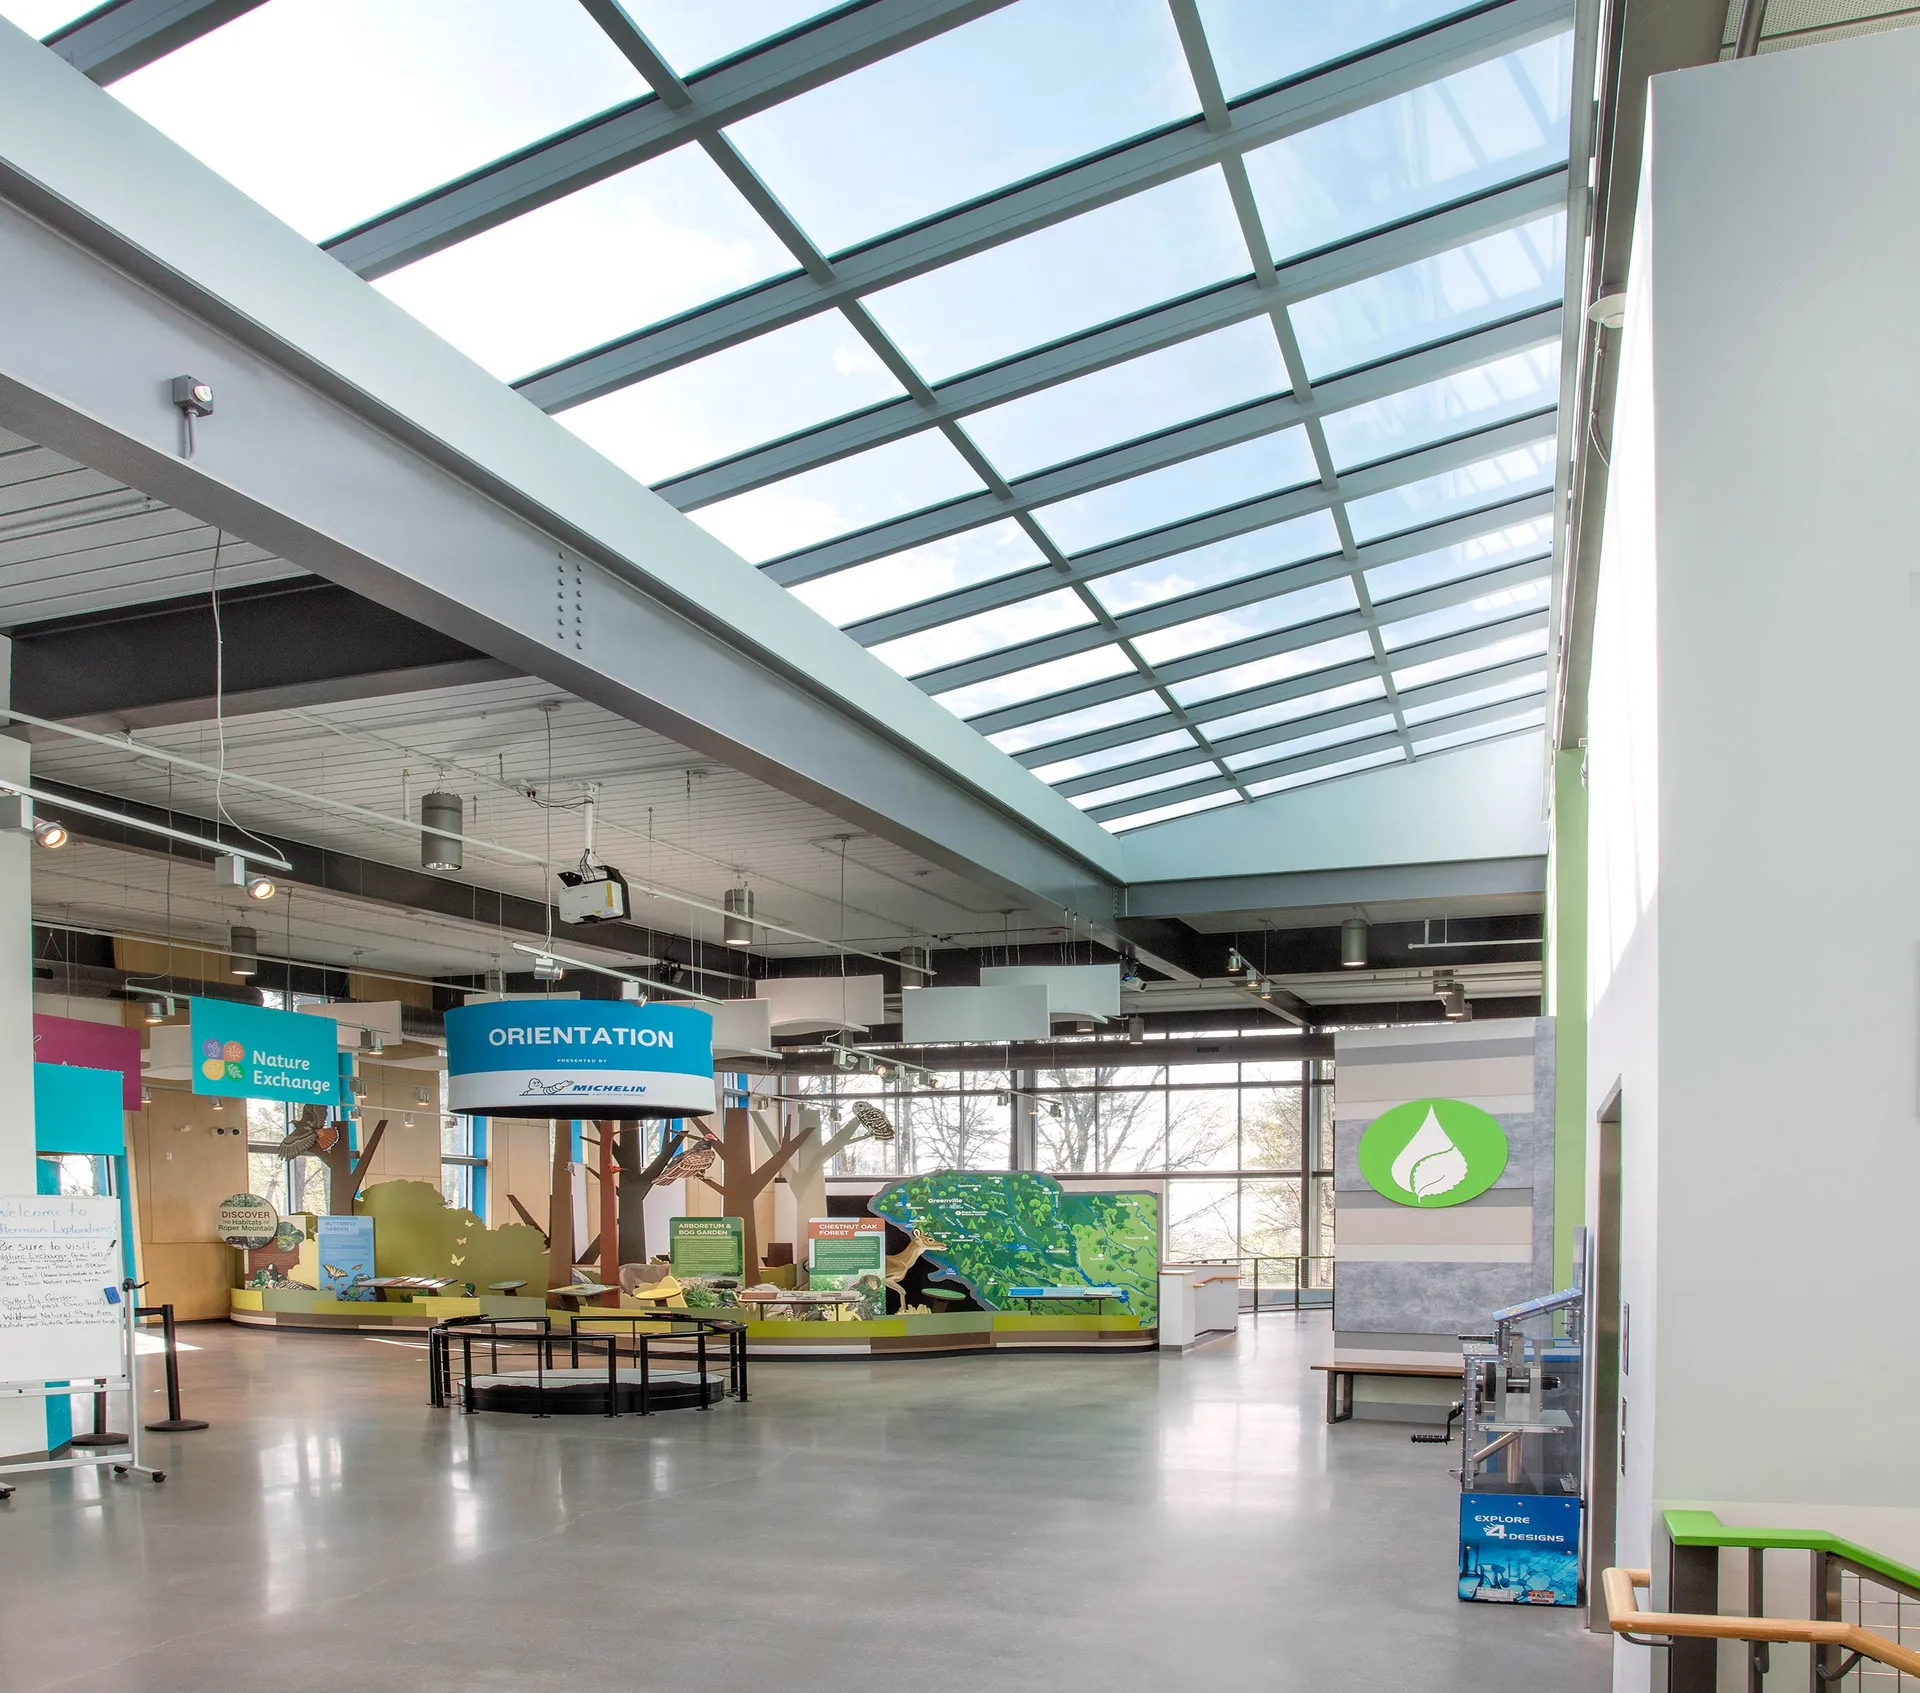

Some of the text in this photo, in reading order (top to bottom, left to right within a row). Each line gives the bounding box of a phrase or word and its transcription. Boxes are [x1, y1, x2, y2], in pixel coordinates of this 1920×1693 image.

[488, 1026, 674, 1048] ORIENTATION
[252, 1050, 310, 1071] Nature
[252, 1071, 330, 1095] Exchange
[572, 1084, 646, 1093] MICHELIN
[68, 1201, 88, 1218] to
[221, 1211, 270, 1219] DISCOVER
[0, 1222, 47, 1235] fternoon
[0, 1241, 16, 1252] Be
[18, 1243, 45, 1252] sure
[50, 1241, 61, 1251] to
[1474, 1515, 1530, 1524] EXPLORE
[1482, 1522, 1564, 1542] ALL 4 DESIGNS
